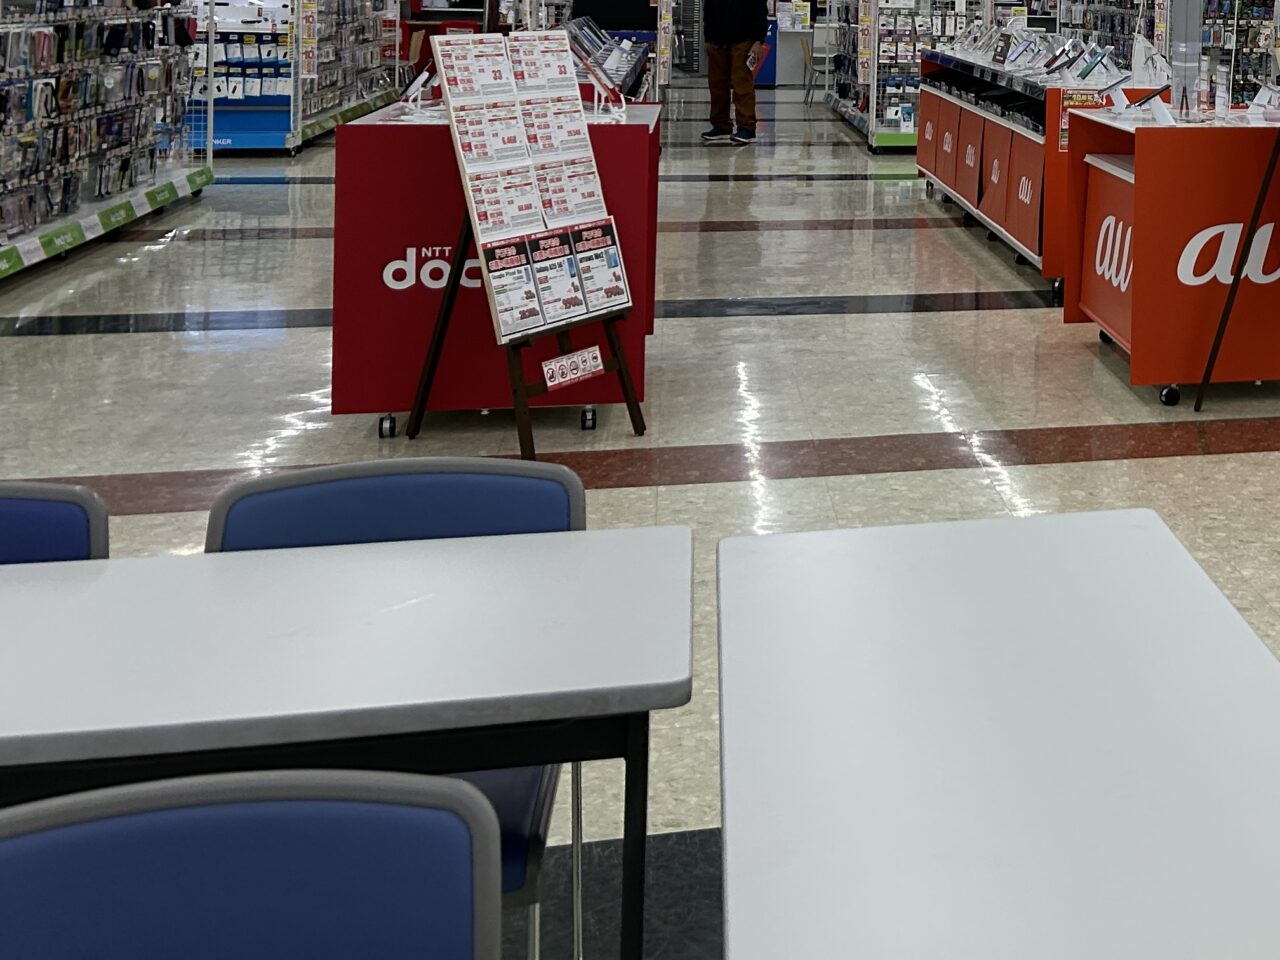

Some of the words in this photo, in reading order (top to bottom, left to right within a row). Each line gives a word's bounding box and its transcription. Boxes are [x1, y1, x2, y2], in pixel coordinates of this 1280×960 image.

[1018, 175, 1033, 205] au
[421, 246, 453, 258] NTT
[1095, 215, 1134, 293] au
